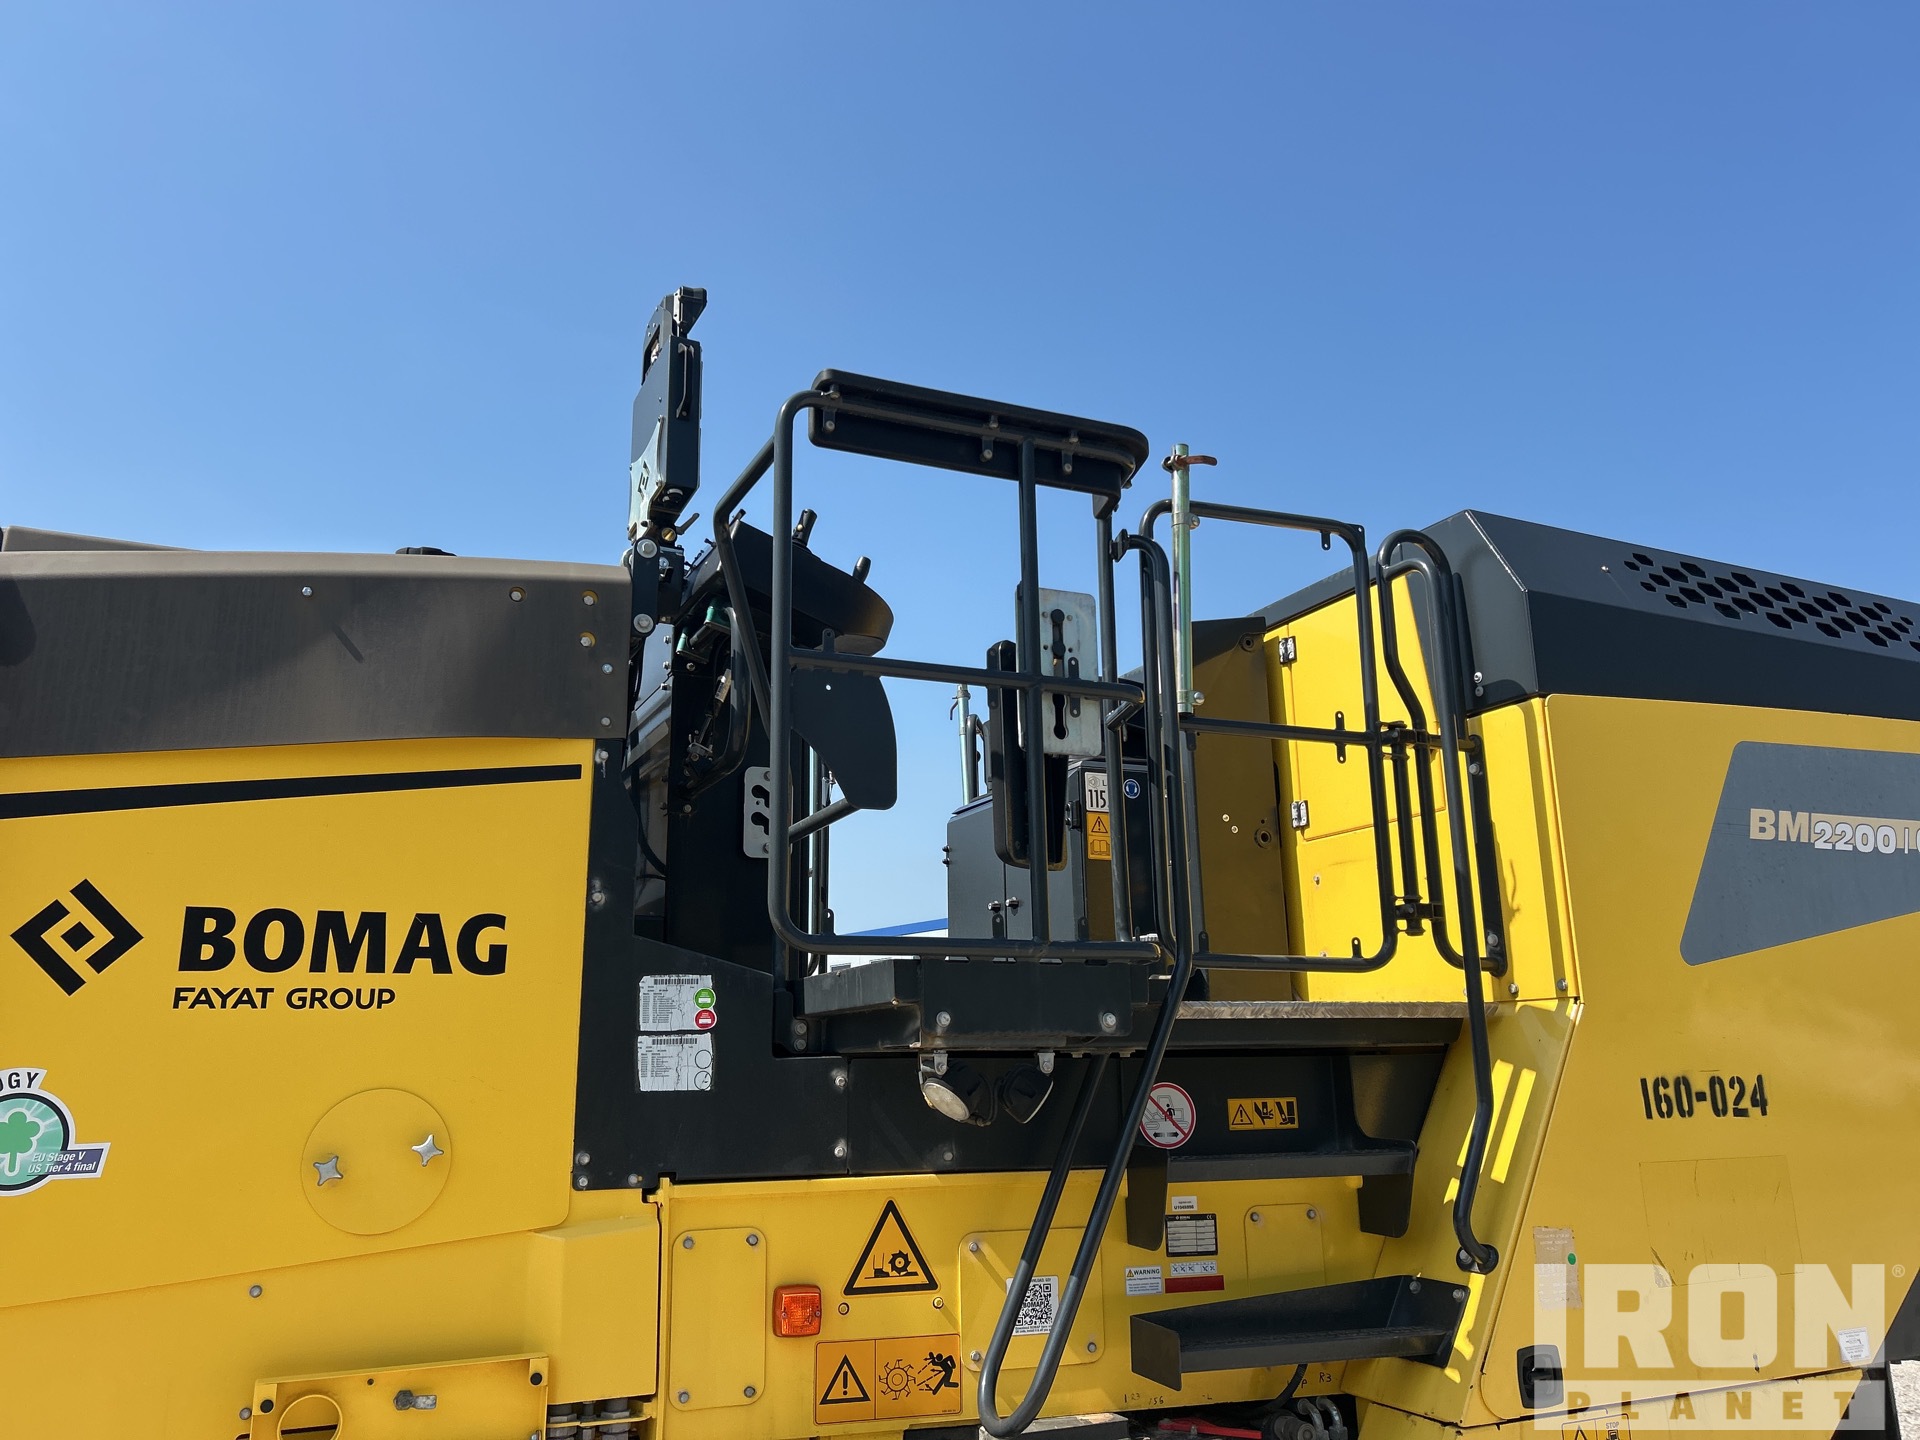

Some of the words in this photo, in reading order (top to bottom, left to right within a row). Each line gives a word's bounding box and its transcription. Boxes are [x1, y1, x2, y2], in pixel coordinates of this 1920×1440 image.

[178, 905, 508, 976] BOMAG
[172, 987, 275, 1010] FAYAT
[286, 987, 397, 1010] GROUP
[1640, 1074, 1769, 1121] 160-024
[32, 1152, 46, 1163] EU
[47, 1152, 76, 1164] Stage
[78, 1151, 86, 1161] V
[28, 1163, 42, 1174] US
[44, 1163, 62, 1173] Tier
[64, 1162, 71, 1172] 4
[73, 1161, 97, 1172] final
[1133, 1268, 1160, 1276] WARNING
[1605, 1421, 1620, 1430] STOP
